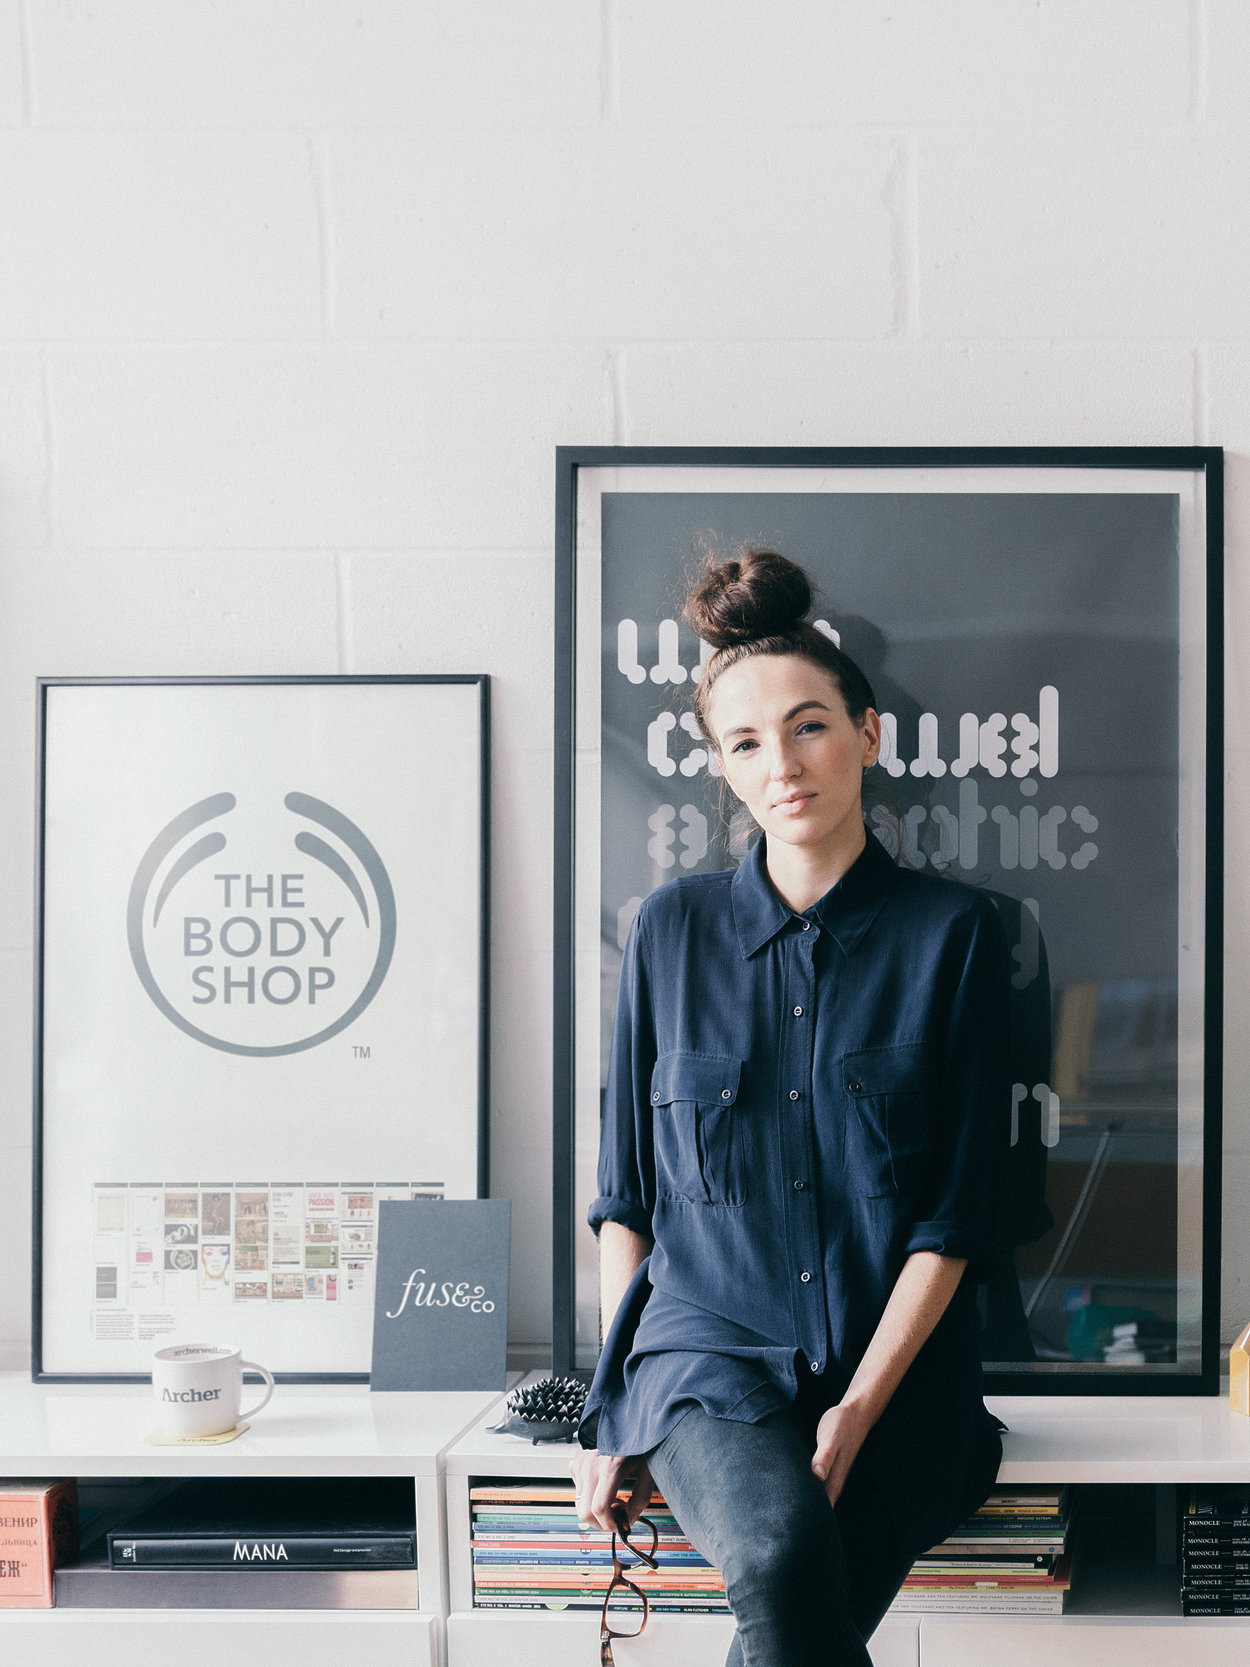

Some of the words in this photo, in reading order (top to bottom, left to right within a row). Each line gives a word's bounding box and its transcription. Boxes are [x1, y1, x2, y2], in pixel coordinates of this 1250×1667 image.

[214, 874, 304, 908] THE
[183, 916, 345, 957] BODY
[191, 966, 336, 1005] SHOP
[352, 1047, 370, 1059] TM
[162, 1387, 221, 1403] Archer
[233, 1541, 288, 1561] MANA
